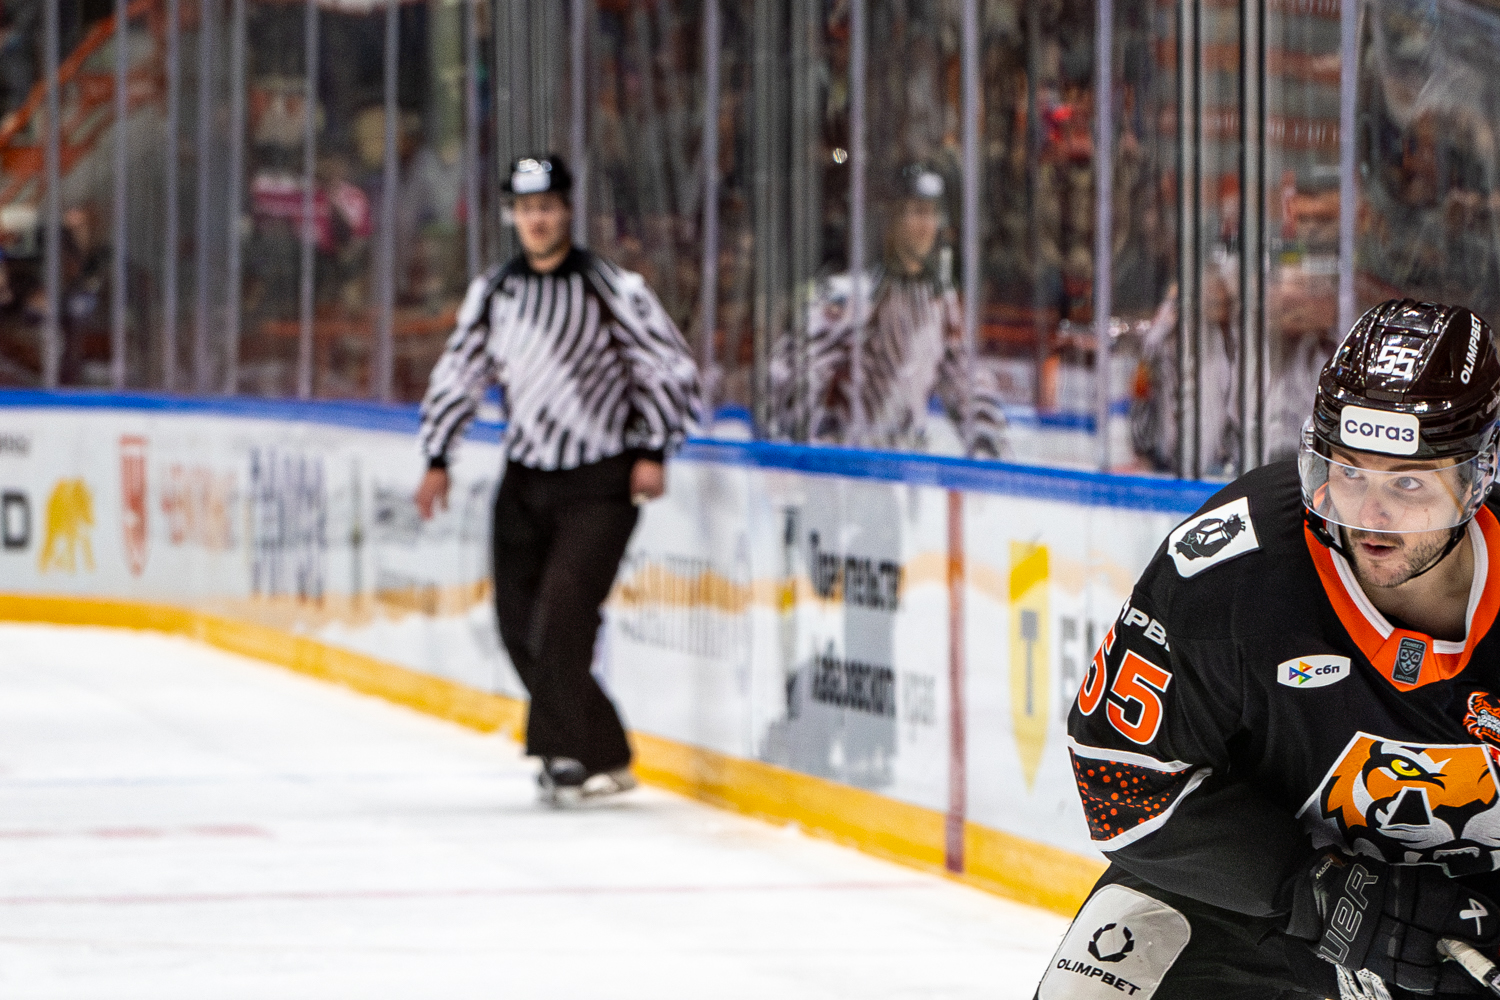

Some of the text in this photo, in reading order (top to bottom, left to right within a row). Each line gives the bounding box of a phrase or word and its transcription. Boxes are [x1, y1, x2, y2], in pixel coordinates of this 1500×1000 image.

[1375, 345, 1419, 377] 55
[1460, 313, 1481, 385] OLIMPBET
[1344, 419, 1415, 442] согаз
[1315, 664, 1340, 676] сбп
[1056, 958, 1141, 996] OLIMPBET
